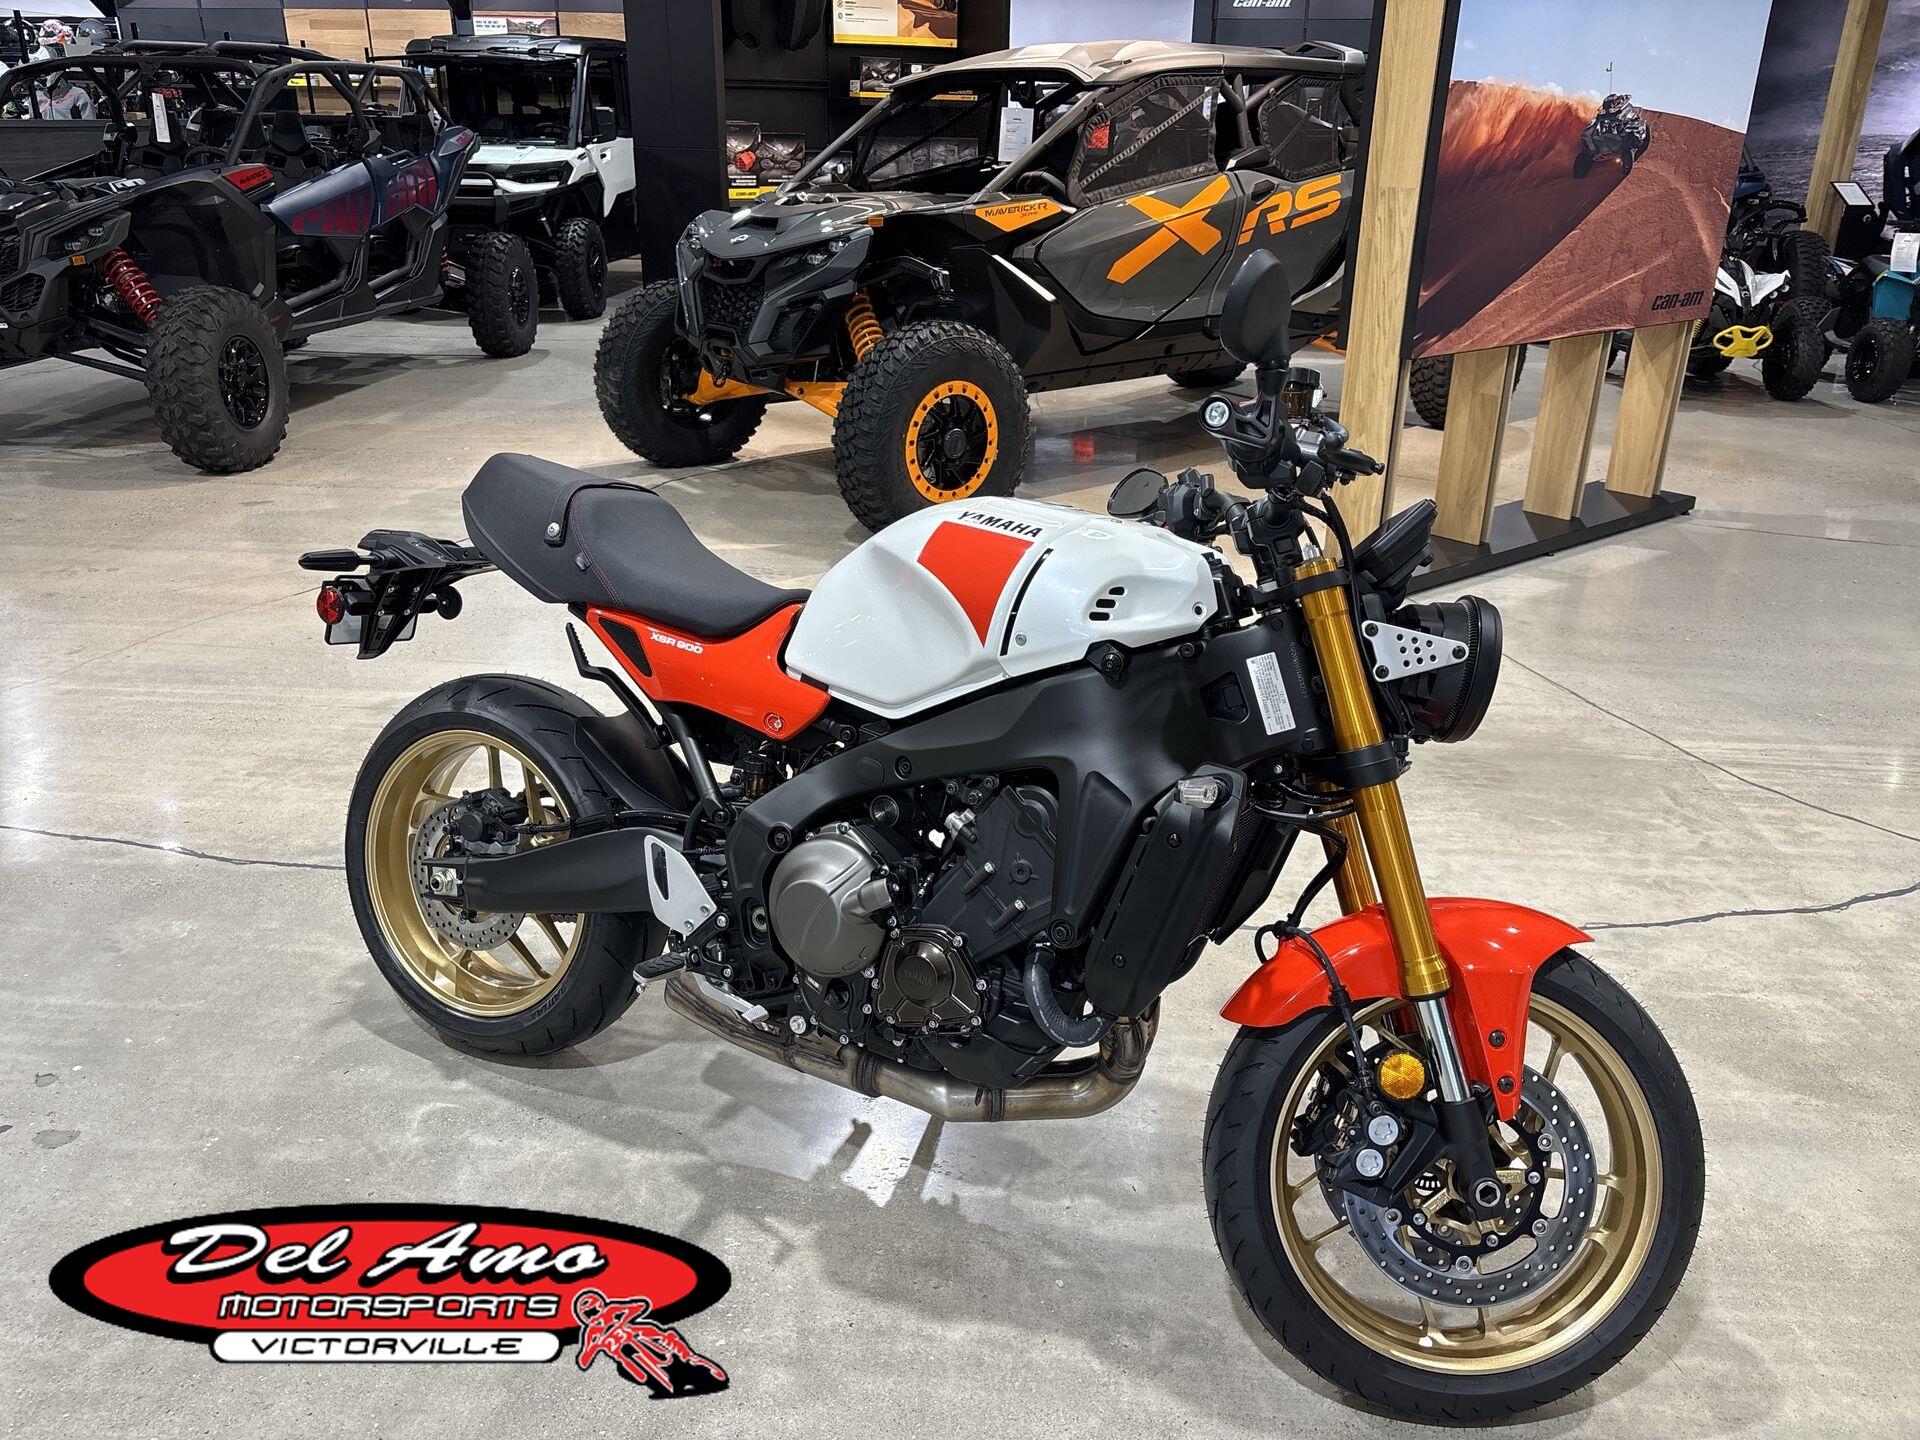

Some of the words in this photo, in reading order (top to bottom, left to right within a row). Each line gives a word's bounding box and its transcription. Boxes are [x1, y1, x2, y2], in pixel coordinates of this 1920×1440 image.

[984, 203, 1037, 217] MAVERICK
[958, 511, 1043, 538] YAMAHA
[650, 631, 677, 647] XSR
[676, 640, 704, 655] 900
[903, 970, 932, 987] YAMAHA
